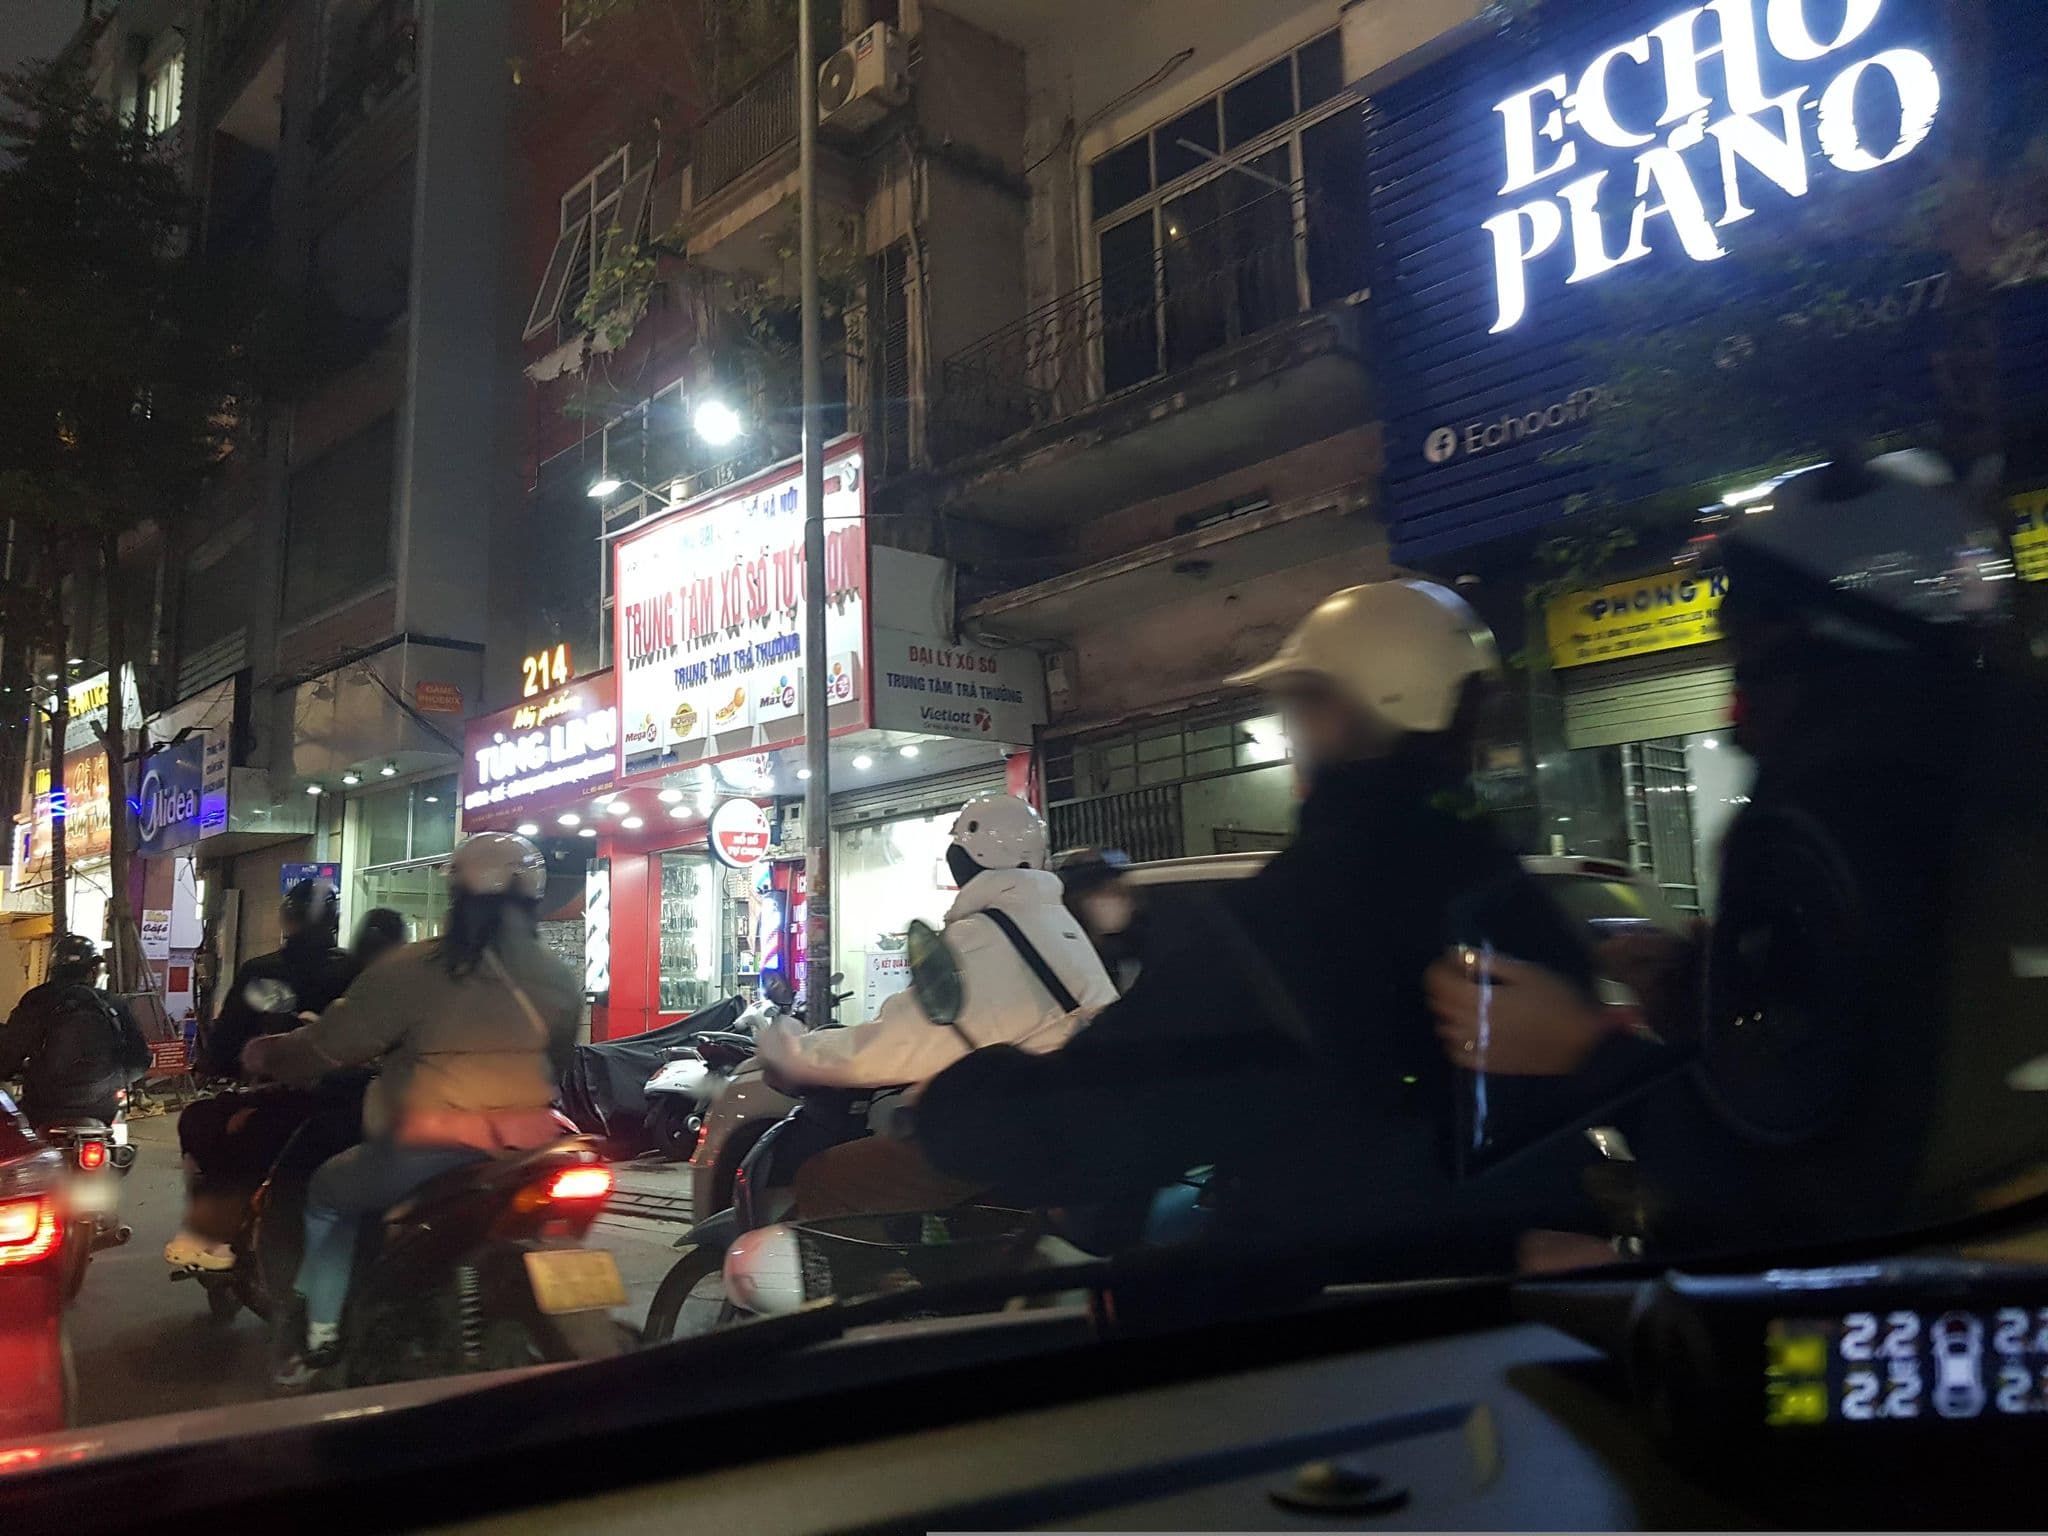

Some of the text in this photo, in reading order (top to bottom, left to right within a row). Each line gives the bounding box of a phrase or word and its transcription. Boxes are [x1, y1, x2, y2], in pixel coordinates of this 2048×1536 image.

[1492, 0, 1886, 197] ECHO
[1481, 48, 1941, 335] PIANO
[625, 591, 674, 660] TRUNG
[523, 643, 568, 698] 214
[674, 661, 707, 686] TRUNG
[710, 653, 731, 676] TÂM
[734, 640, 753, 669] TRẢ
[886, 672, 925, 691] TRUNG
[928, 676, 952, 695] TÂM
[955, 681, 977, 698] TRẢ
[760, 695, 781, 708] Max
[920, 705, 971, 724] Vietlott
[625, 731, 646, 743] Mega
[152, 787, 196, 829] Midea
